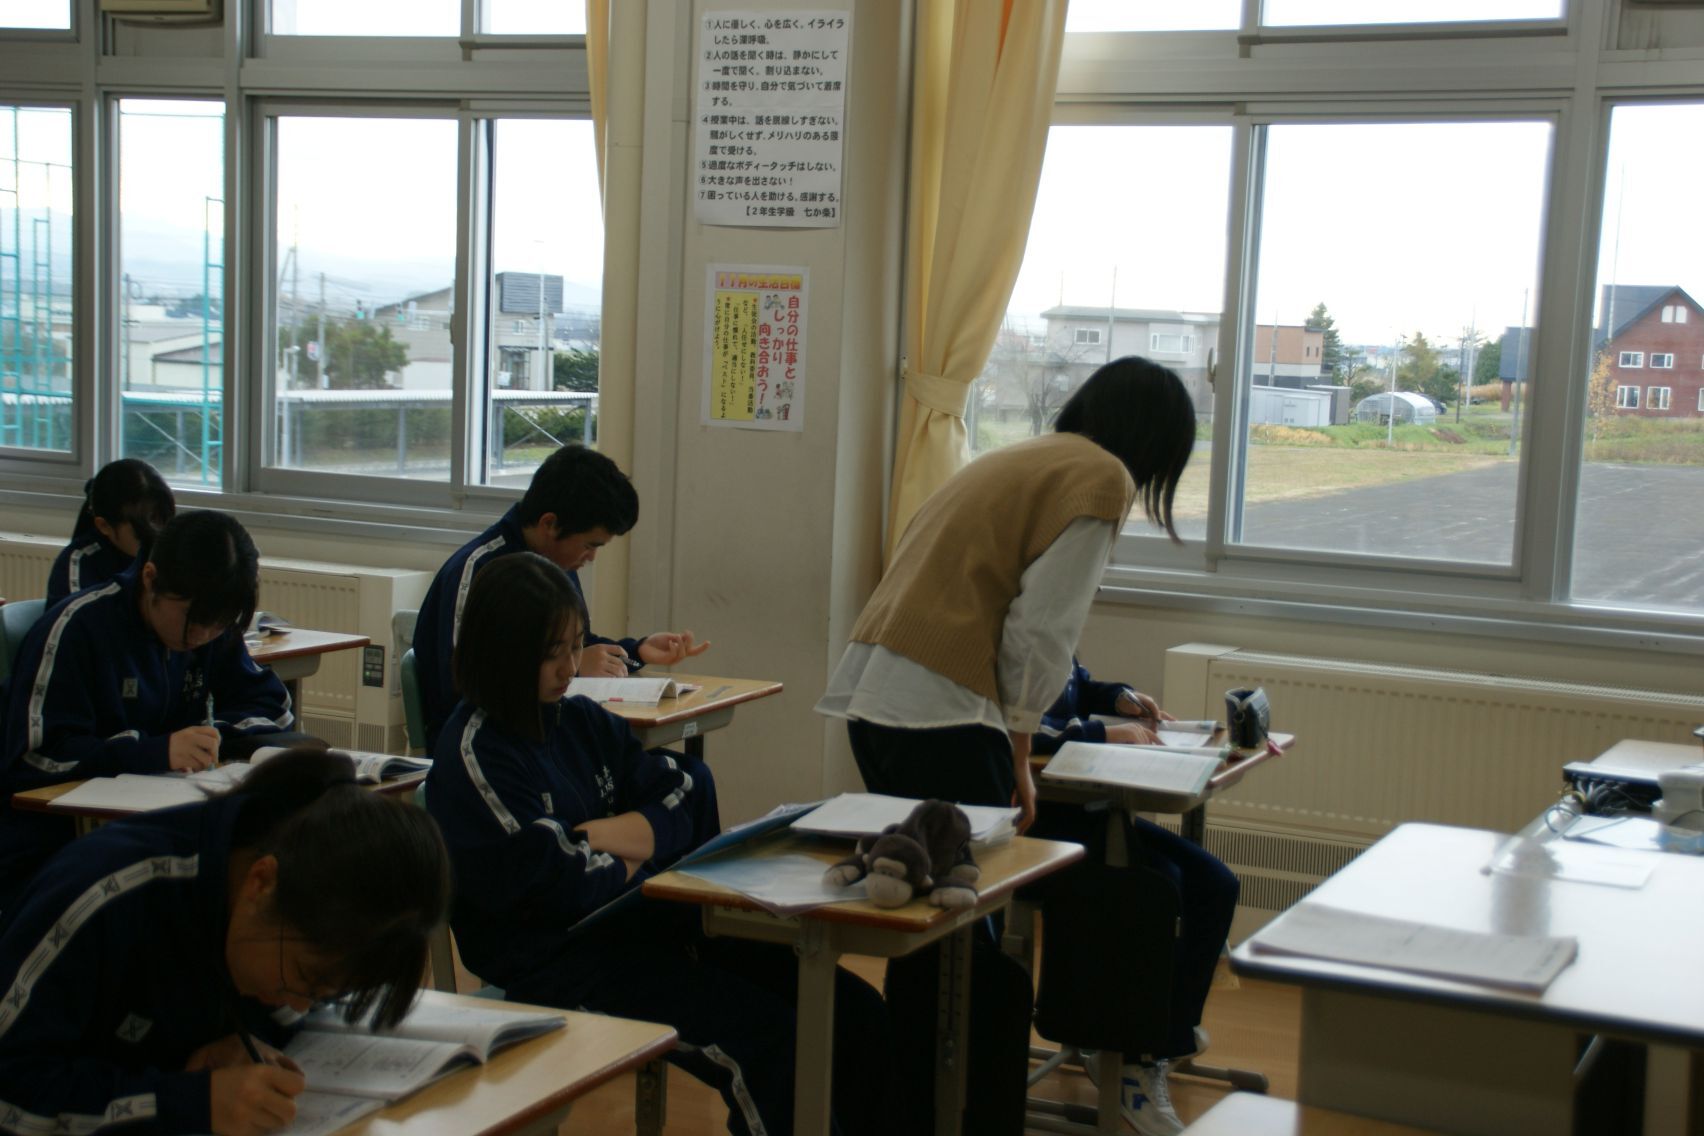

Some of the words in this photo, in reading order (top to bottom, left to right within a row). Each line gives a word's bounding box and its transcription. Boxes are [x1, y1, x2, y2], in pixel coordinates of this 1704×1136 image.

[712, 97, 733, 106] する。
[708, 145, 757, 156] 度で受ける。
[757, 323, 771, 405] 向き合おう！
[772, 310, 785, 365] しっかり
[785, 296, 800, 380] 自分の仕事と
